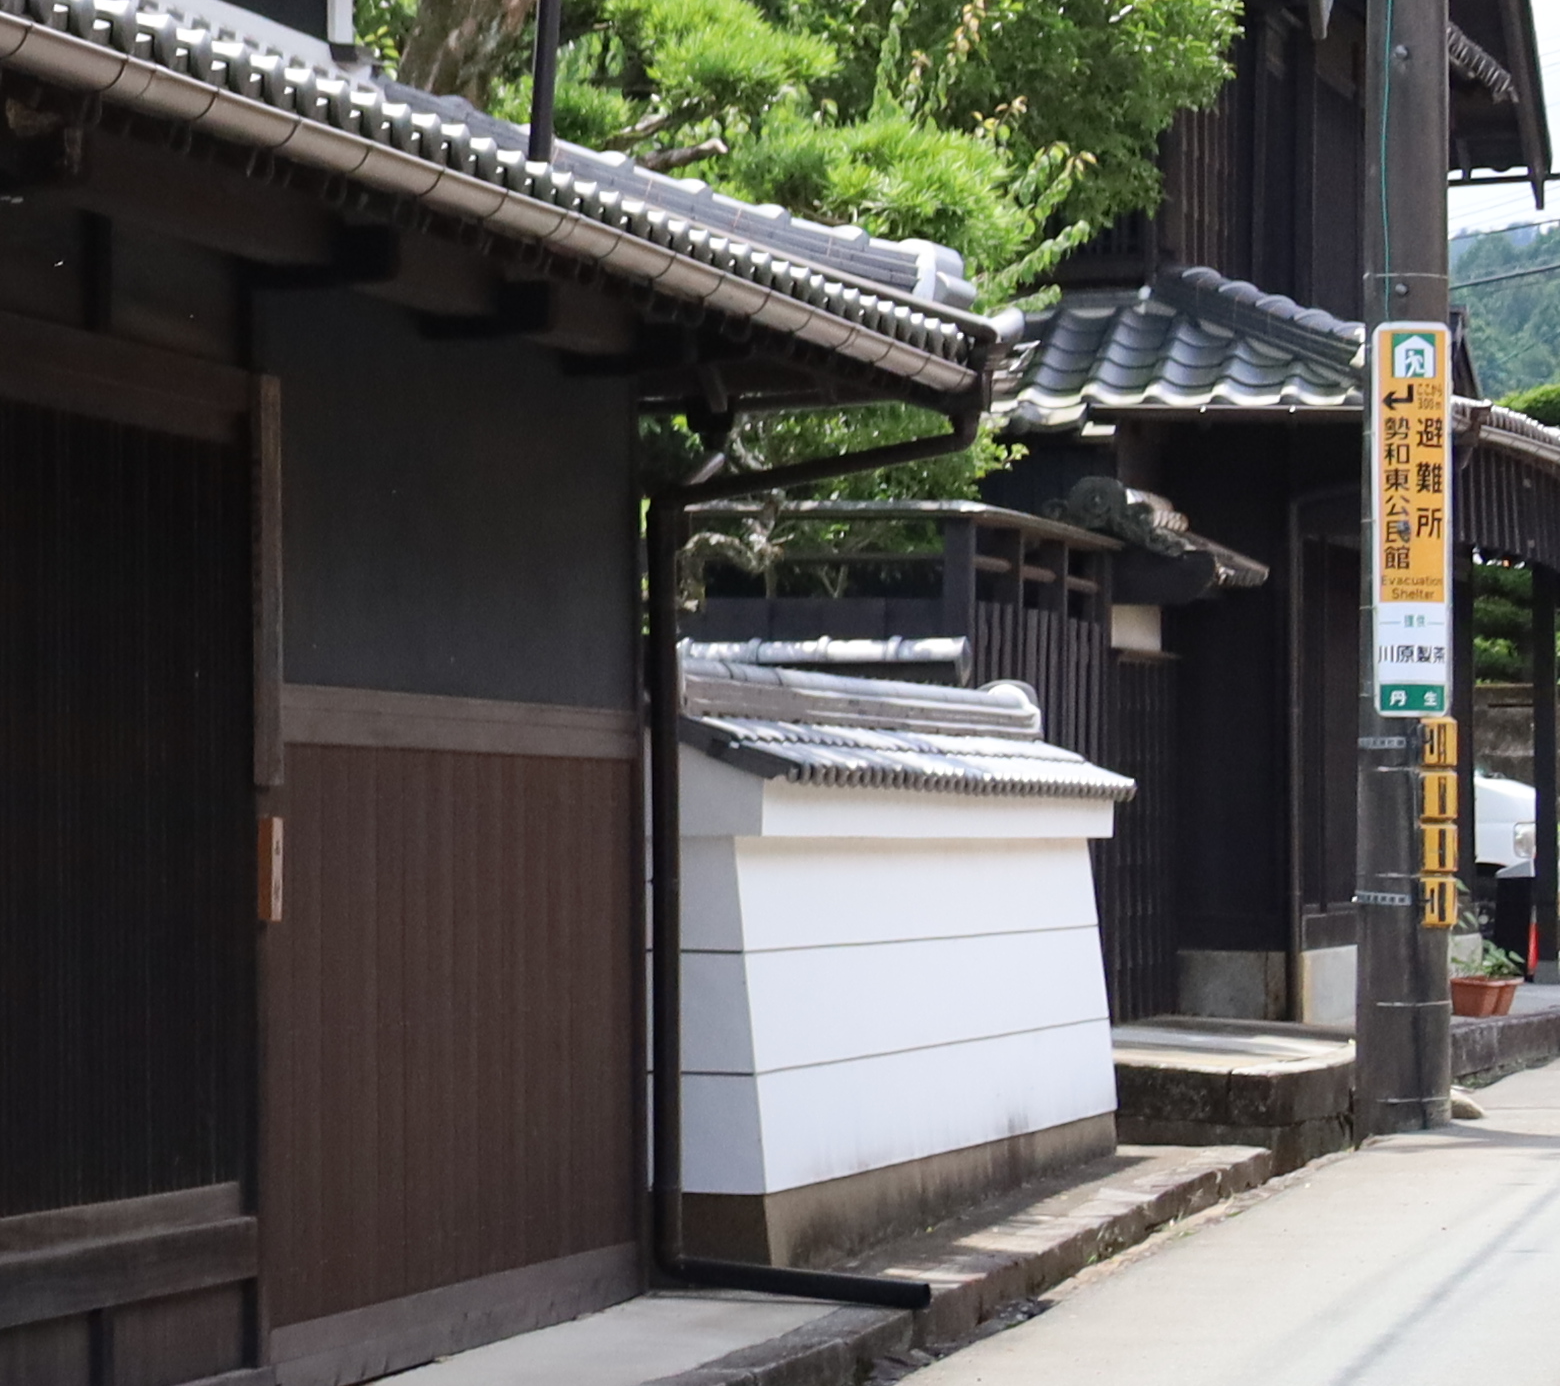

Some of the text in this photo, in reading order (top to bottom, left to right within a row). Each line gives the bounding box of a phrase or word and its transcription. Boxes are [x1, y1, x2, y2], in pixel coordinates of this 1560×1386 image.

[1416, 417, 1443, 539] 避難所
[1383, 416, 1411, 570] 勢和東公民館
[1381, 575, 1443, 587] Evacuation
[1391, 588, 1434, 600] Shelter
[1378, 644, 1446, 664] 川原製茶
